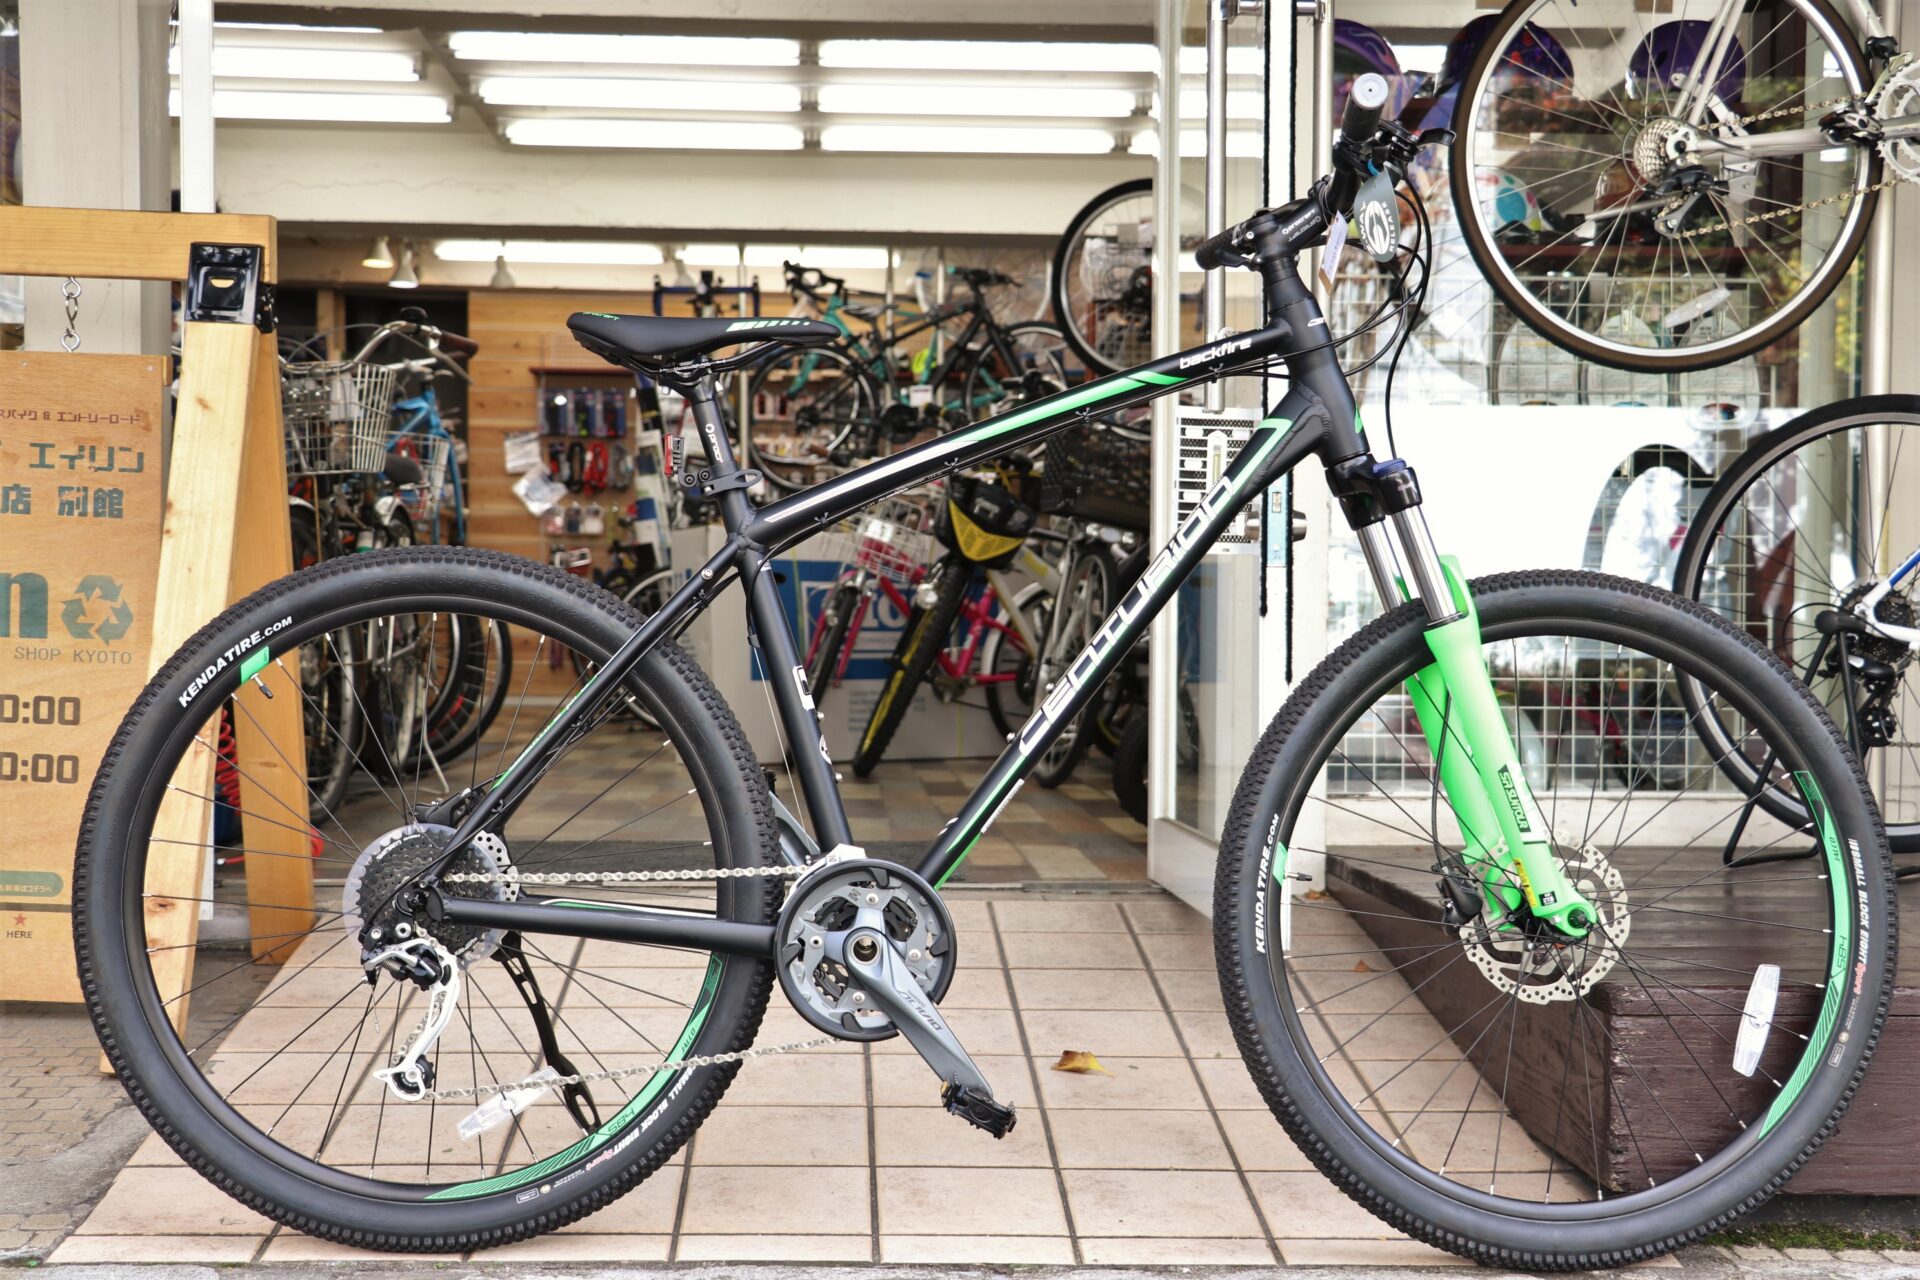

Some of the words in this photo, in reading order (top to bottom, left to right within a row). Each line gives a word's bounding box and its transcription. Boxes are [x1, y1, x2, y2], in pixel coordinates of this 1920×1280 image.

[1381, 200, 1396, 252] RELEASE
[1179, 338, 1252, 369] backfire
[57, 411, 141, 424] エントリーロード
[29, 442, 145, 473] エイリン
[57, 486, 124, 519] 別館
[1019, 475, 1234, 757] CENTURION
[14, 646, 61, 661] SHOP
[73, 649, 132, 665] KYOTO
[0, 694, 81, 726] 0:00
[0, 752, 80, 784] 0:00
[1507, 787, 1528, 830] SUNTOUR
[1850, 848, 1866, 887] SMALL
[1858, 889, 1869, 930] BLOCK
[6, 930, 33, 939] HERE
[1858, 929, 1869, 965] EIGHT
[1836, 935, 1848, 969] 584
[607, 1107, 636, 1136] 584
[640, 1098, 669, 1133] BLOCK
[612, 1127, 640, 1156] EIGHT
